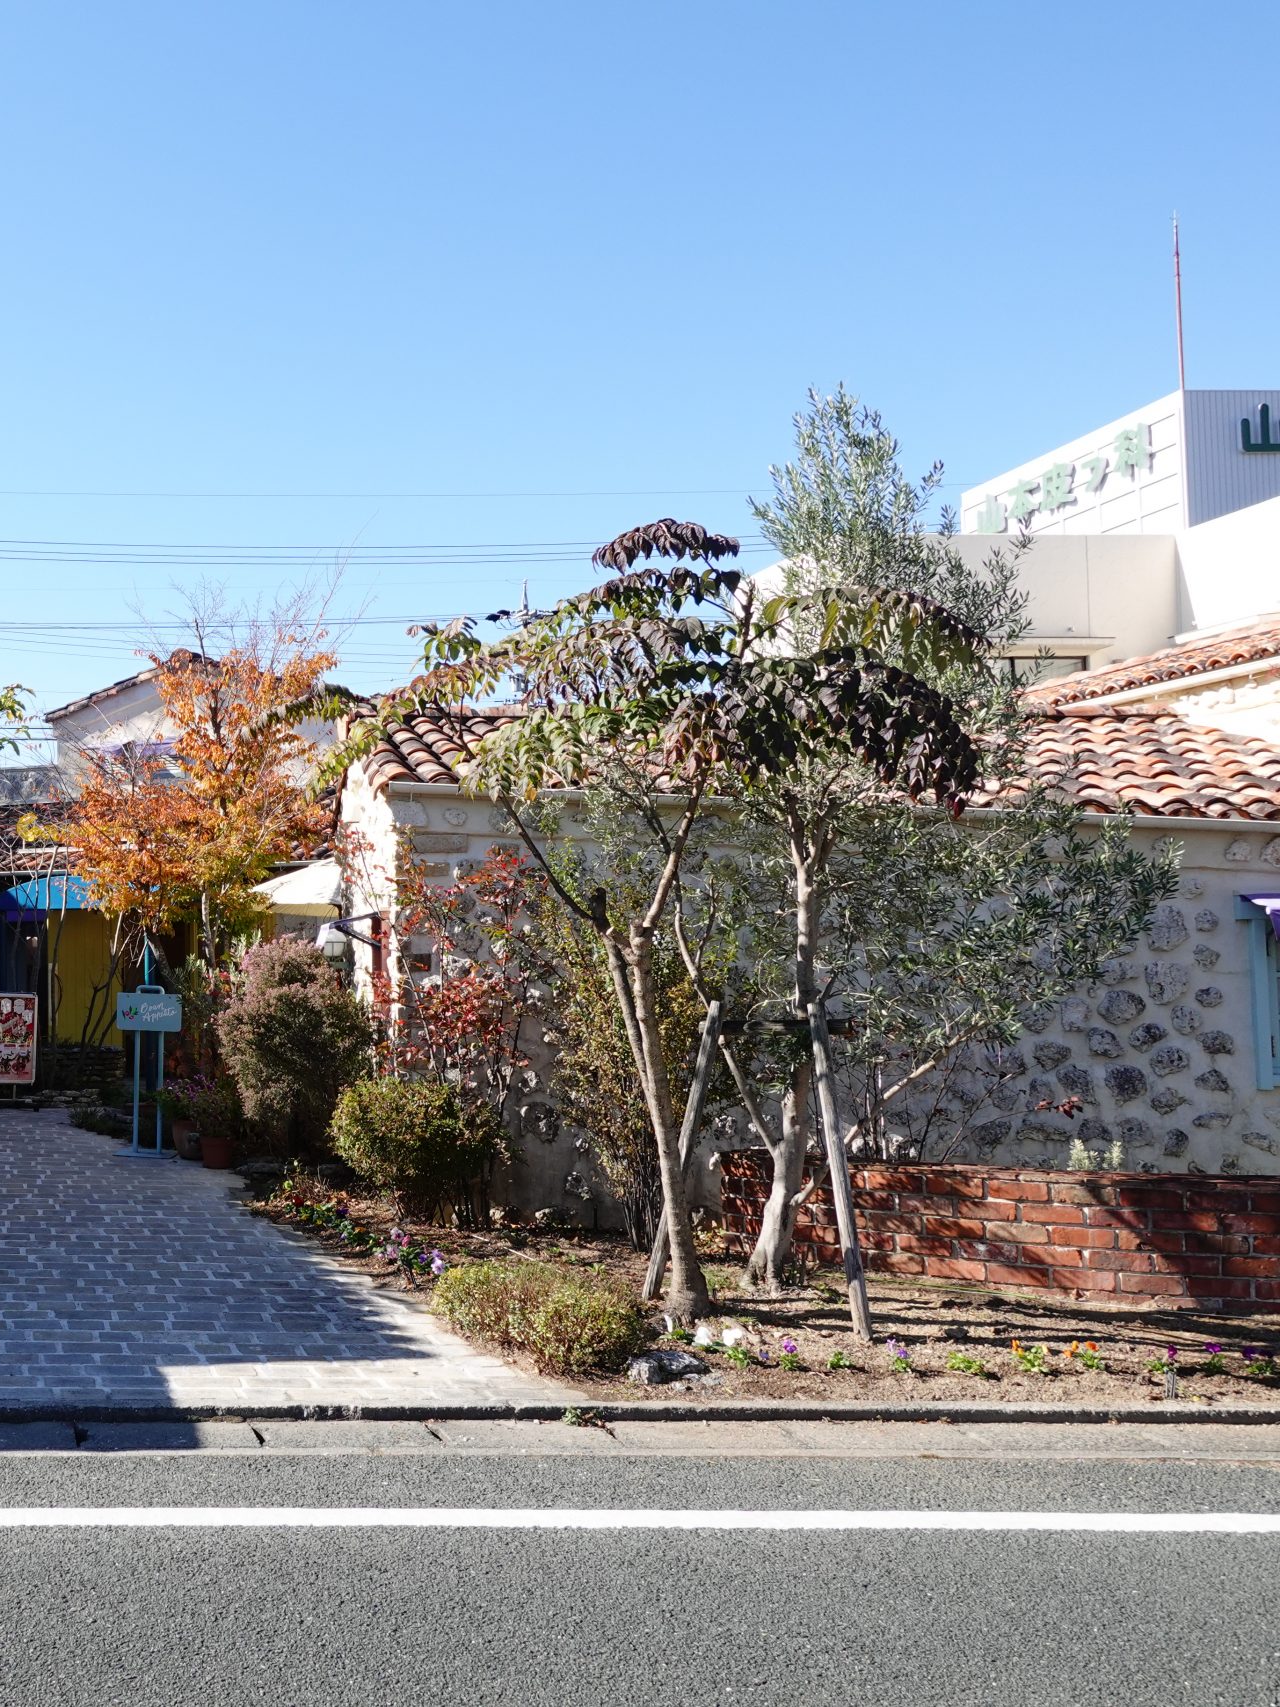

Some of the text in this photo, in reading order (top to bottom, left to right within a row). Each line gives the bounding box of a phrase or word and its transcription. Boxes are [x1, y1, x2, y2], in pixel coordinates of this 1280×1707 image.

[976, 422, 1154, 534] 山本皮フ科
